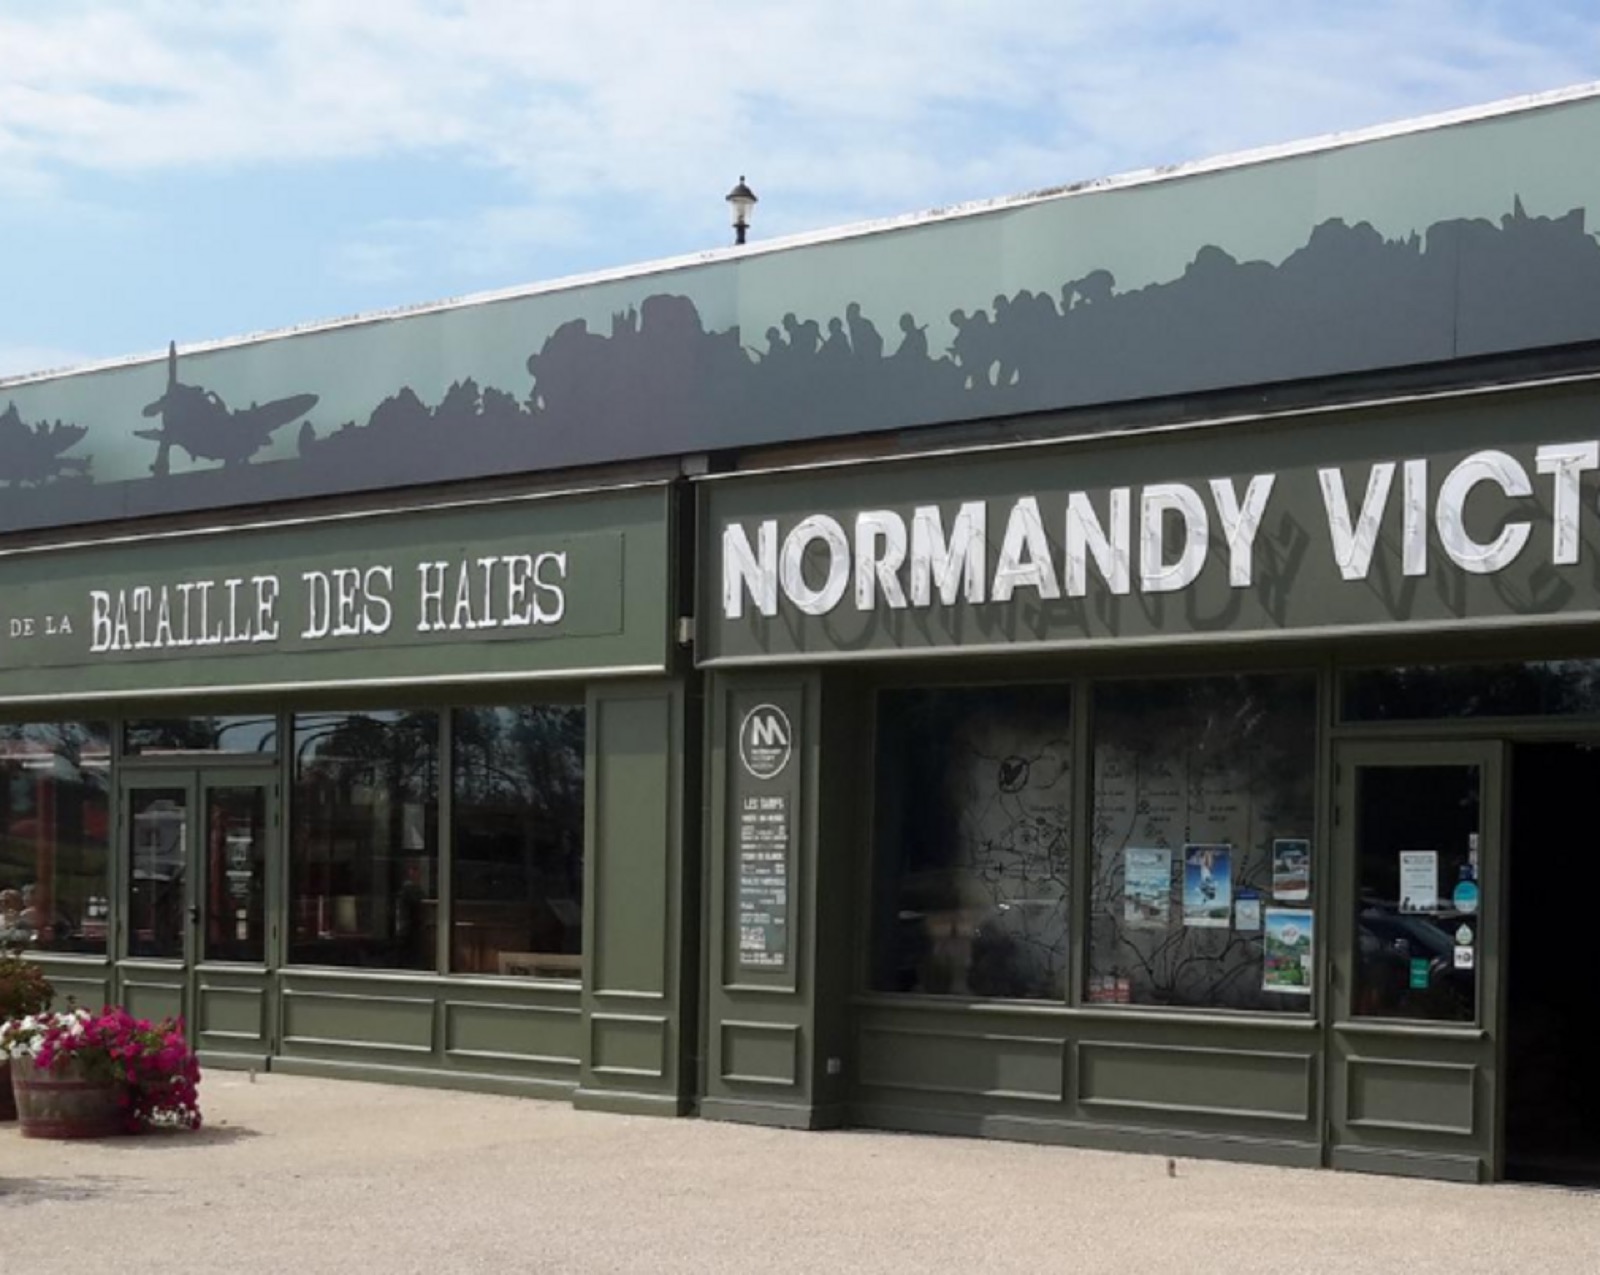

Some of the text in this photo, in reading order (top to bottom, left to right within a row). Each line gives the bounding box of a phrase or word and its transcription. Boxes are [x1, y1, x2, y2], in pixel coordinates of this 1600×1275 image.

[723, 443, 1599, 617] NORMANDY VICT
[11, 552, 566, 651] DE LA BATAILLE DES HAIES
